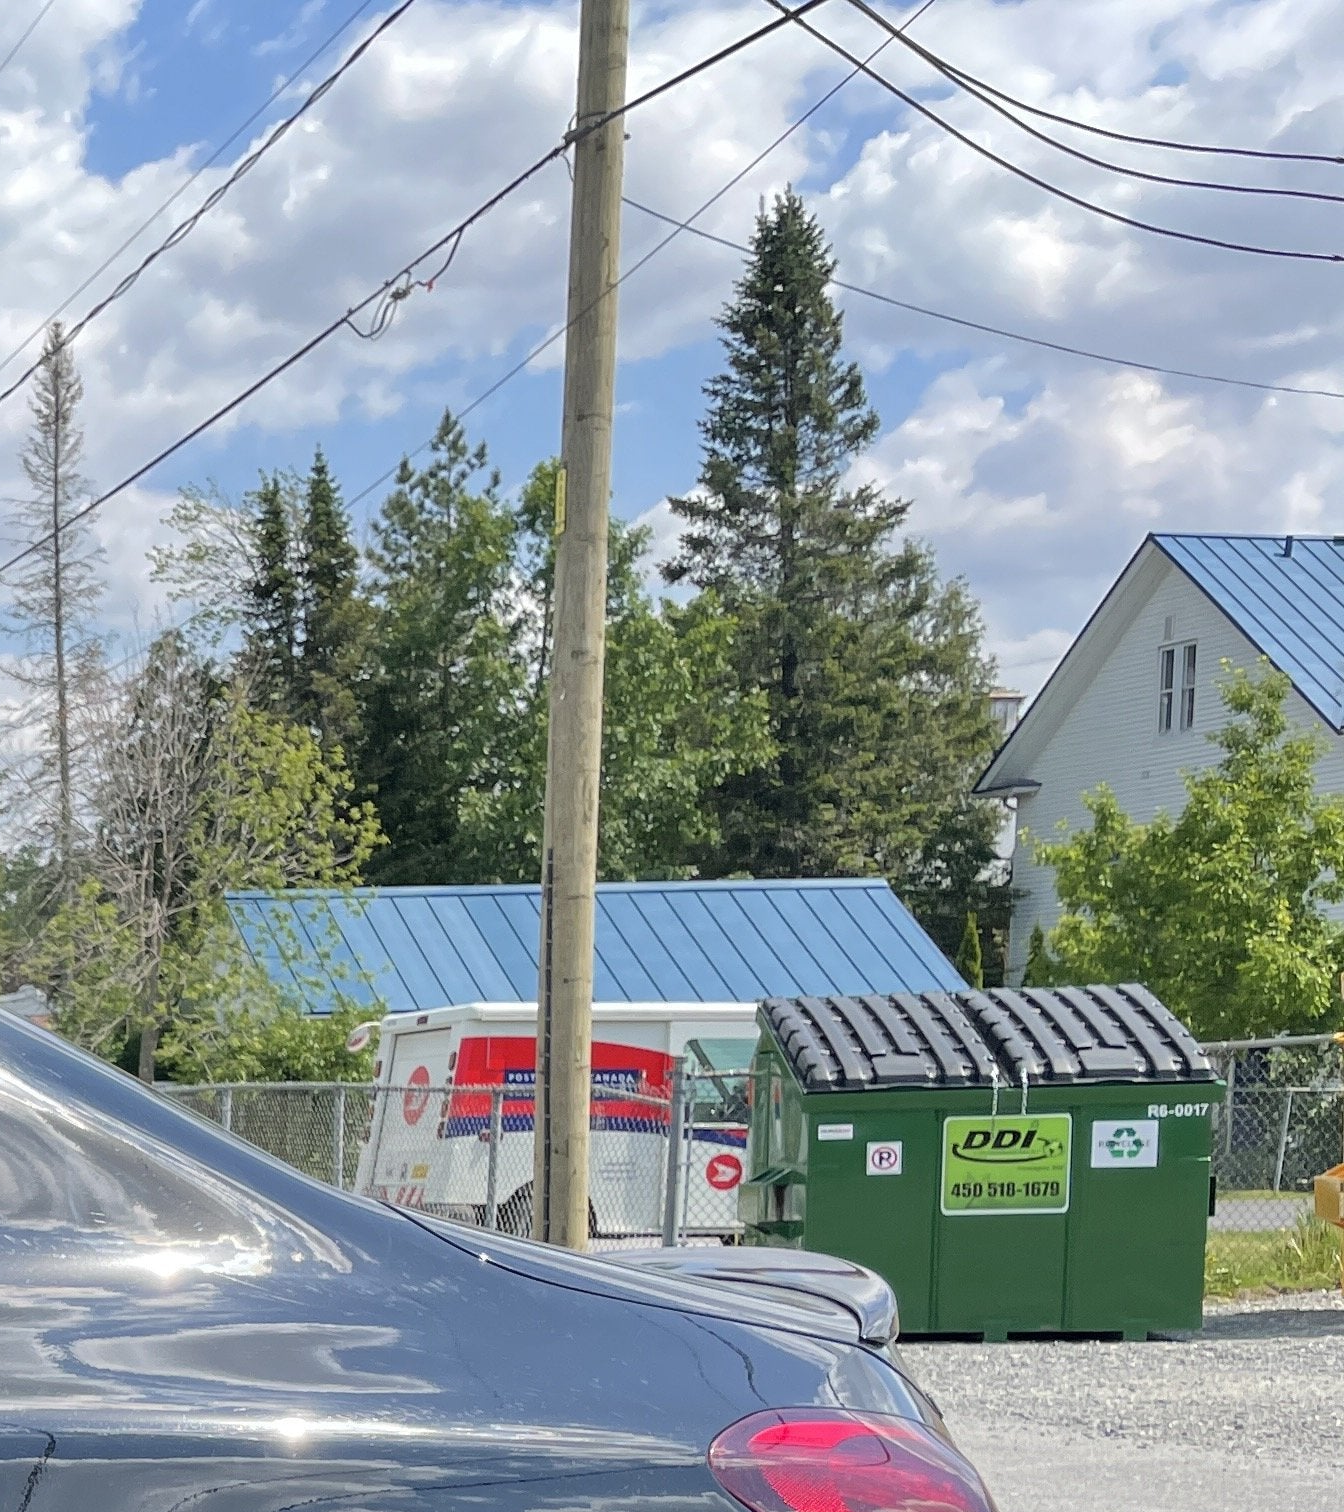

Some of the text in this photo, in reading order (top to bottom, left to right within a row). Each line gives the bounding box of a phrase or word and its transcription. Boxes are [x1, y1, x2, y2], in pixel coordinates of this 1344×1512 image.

[591, 1072, 635, 1084] ANADA
[1147, 1103, 1209, 1117] R6-0017
[963, 1130, 1038, 1150] DDI
[951, 1181, 1060, 1198] 450 518-1679
